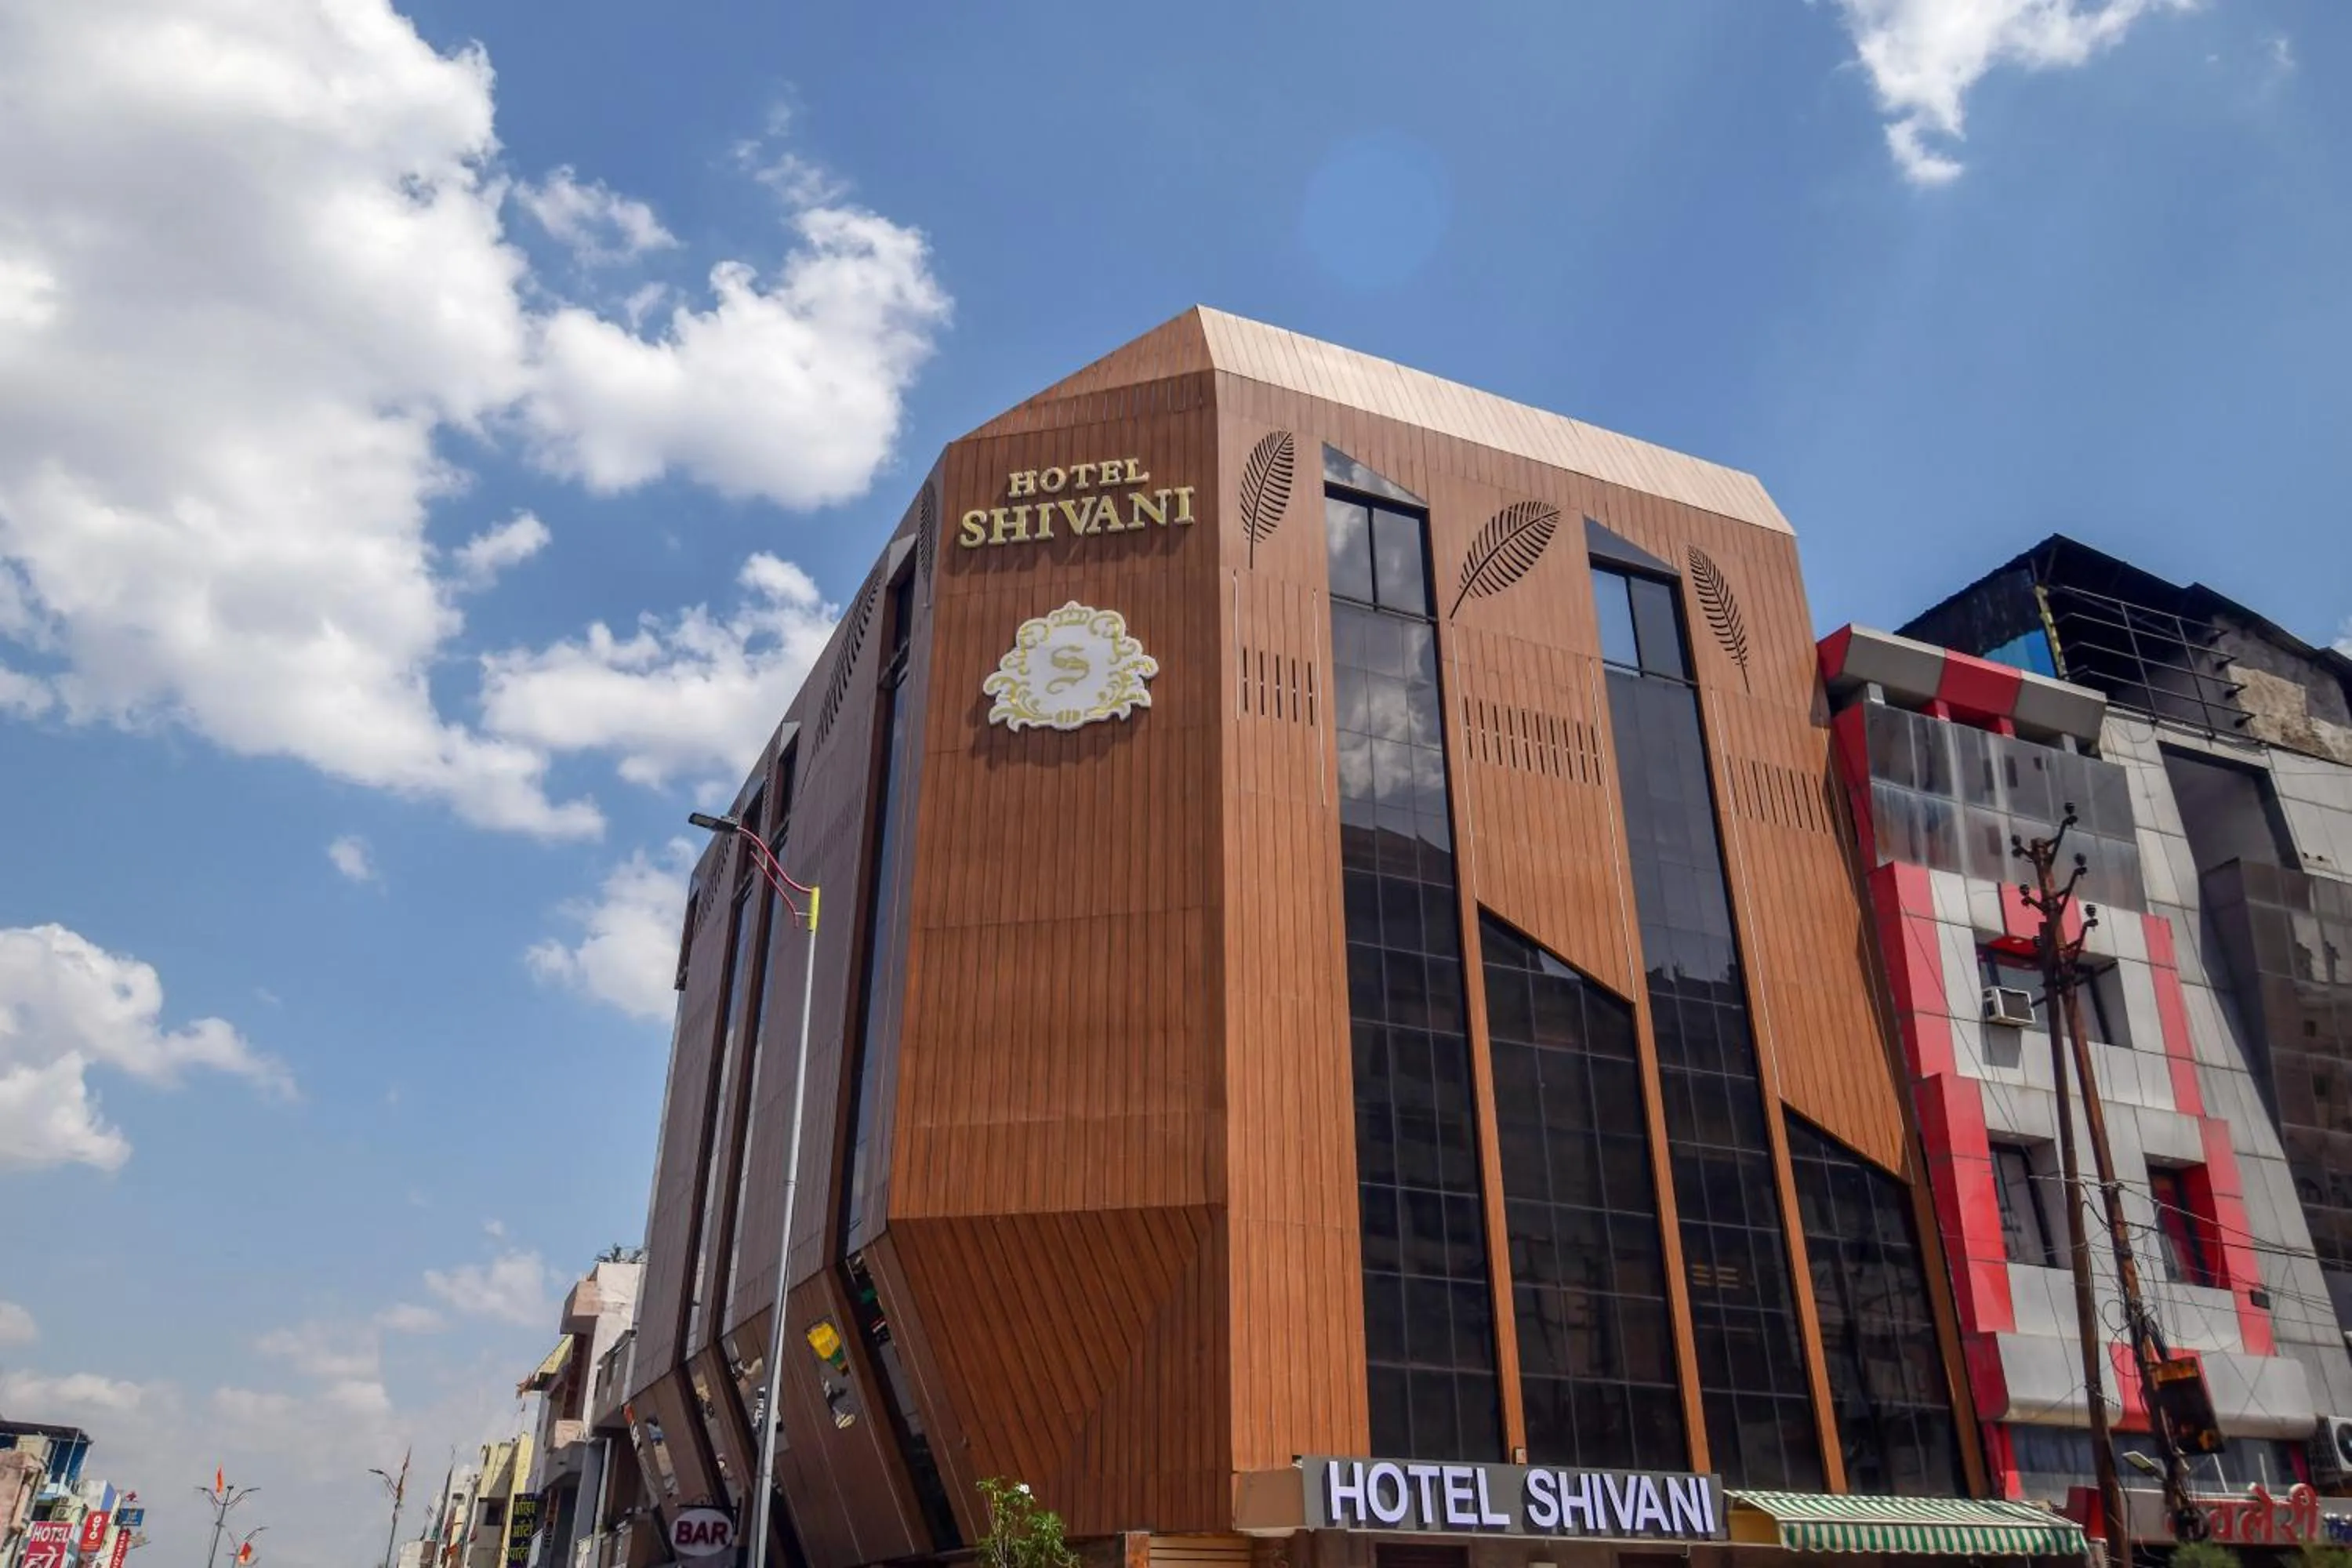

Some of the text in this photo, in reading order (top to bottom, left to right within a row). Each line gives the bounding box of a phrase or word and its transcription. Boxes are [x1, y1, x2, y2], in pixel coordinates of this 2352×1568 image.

[1007, 458, 1150, 498] HOTEL
[959, 486, 1196, 549] SHIVANI
[1328, 1461, 1717, 1533] HOTEL SHIVANI
[89, 1515, 103, 1541] OYO
[675, 1520, 728, 1545] BAR
